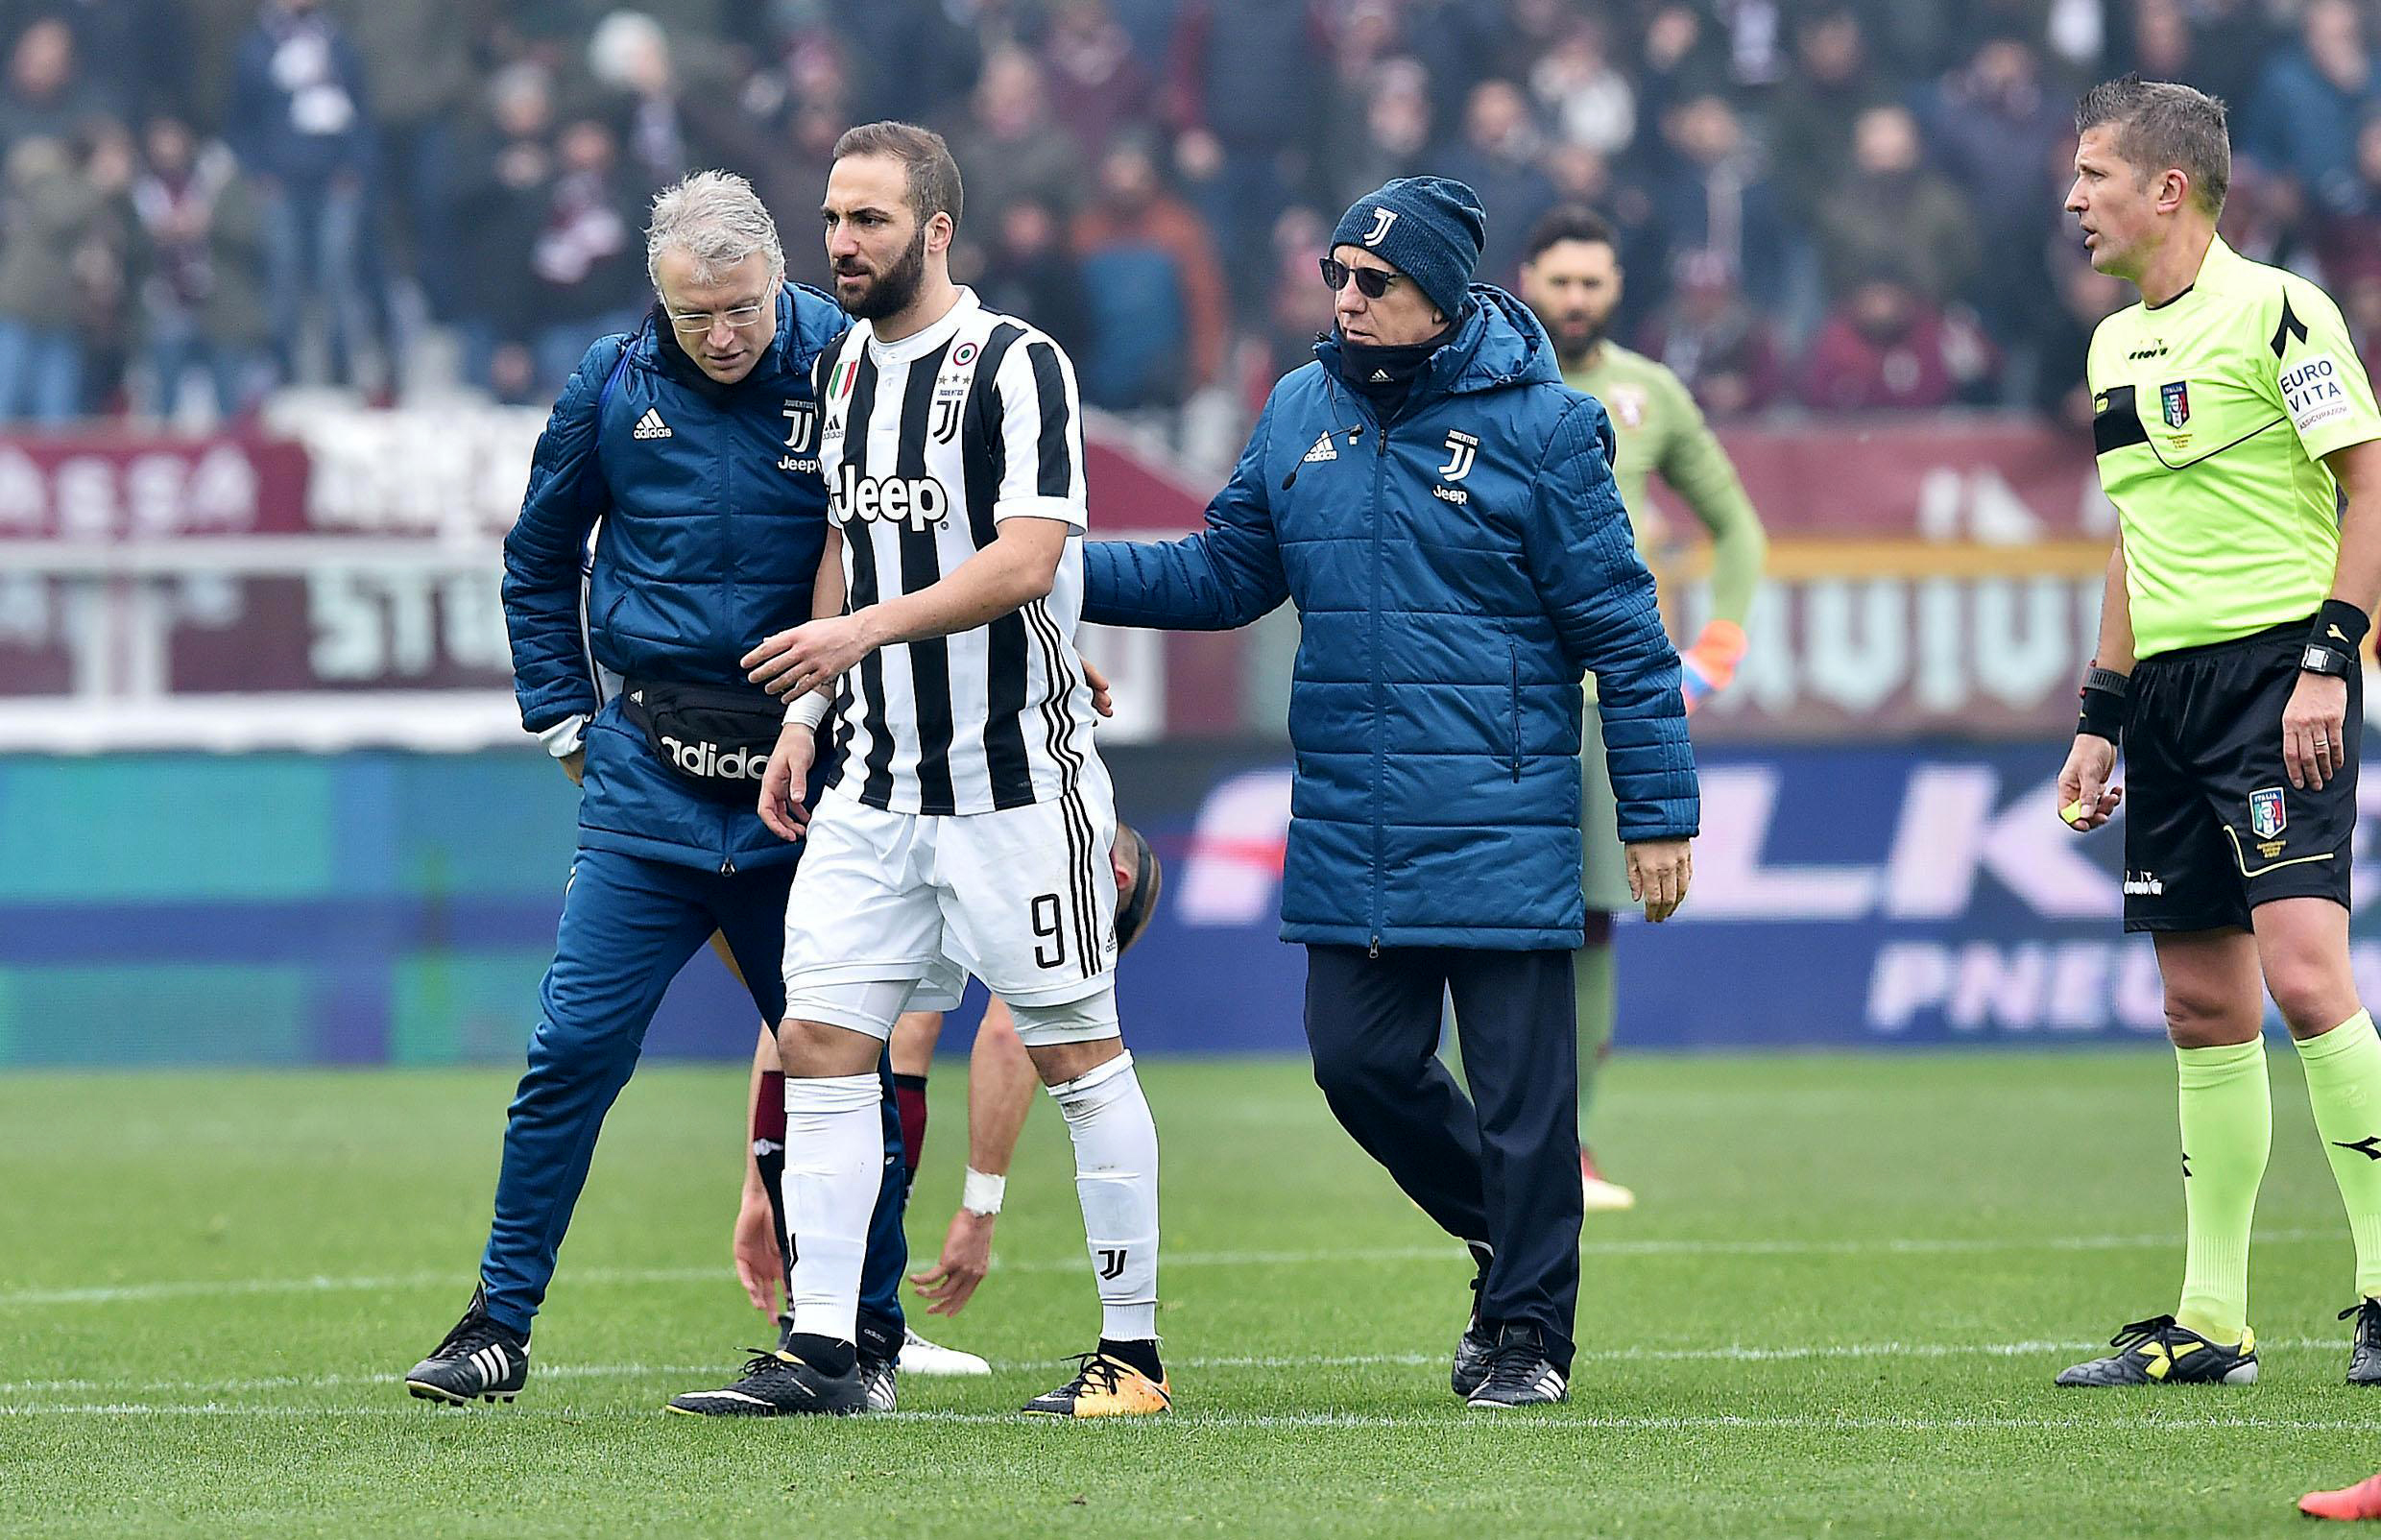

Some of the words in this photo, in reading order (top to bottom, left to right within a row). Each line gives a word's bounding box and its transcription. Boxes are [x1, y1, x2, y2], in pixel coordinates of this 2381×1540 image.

[2280, 360, 2332, 395] EURO
[2289, 381, 2341, 413] VITA
[634, 427, 673, 440] adidas
[778, 455, 817, 473] Jeep
[1304, 450, 1337, 463] adidas
[832, 465, 948, 532] Jeep
[1433, 484, 1468, 505] Jeep
[1031, 894, 1065, 969] 9
